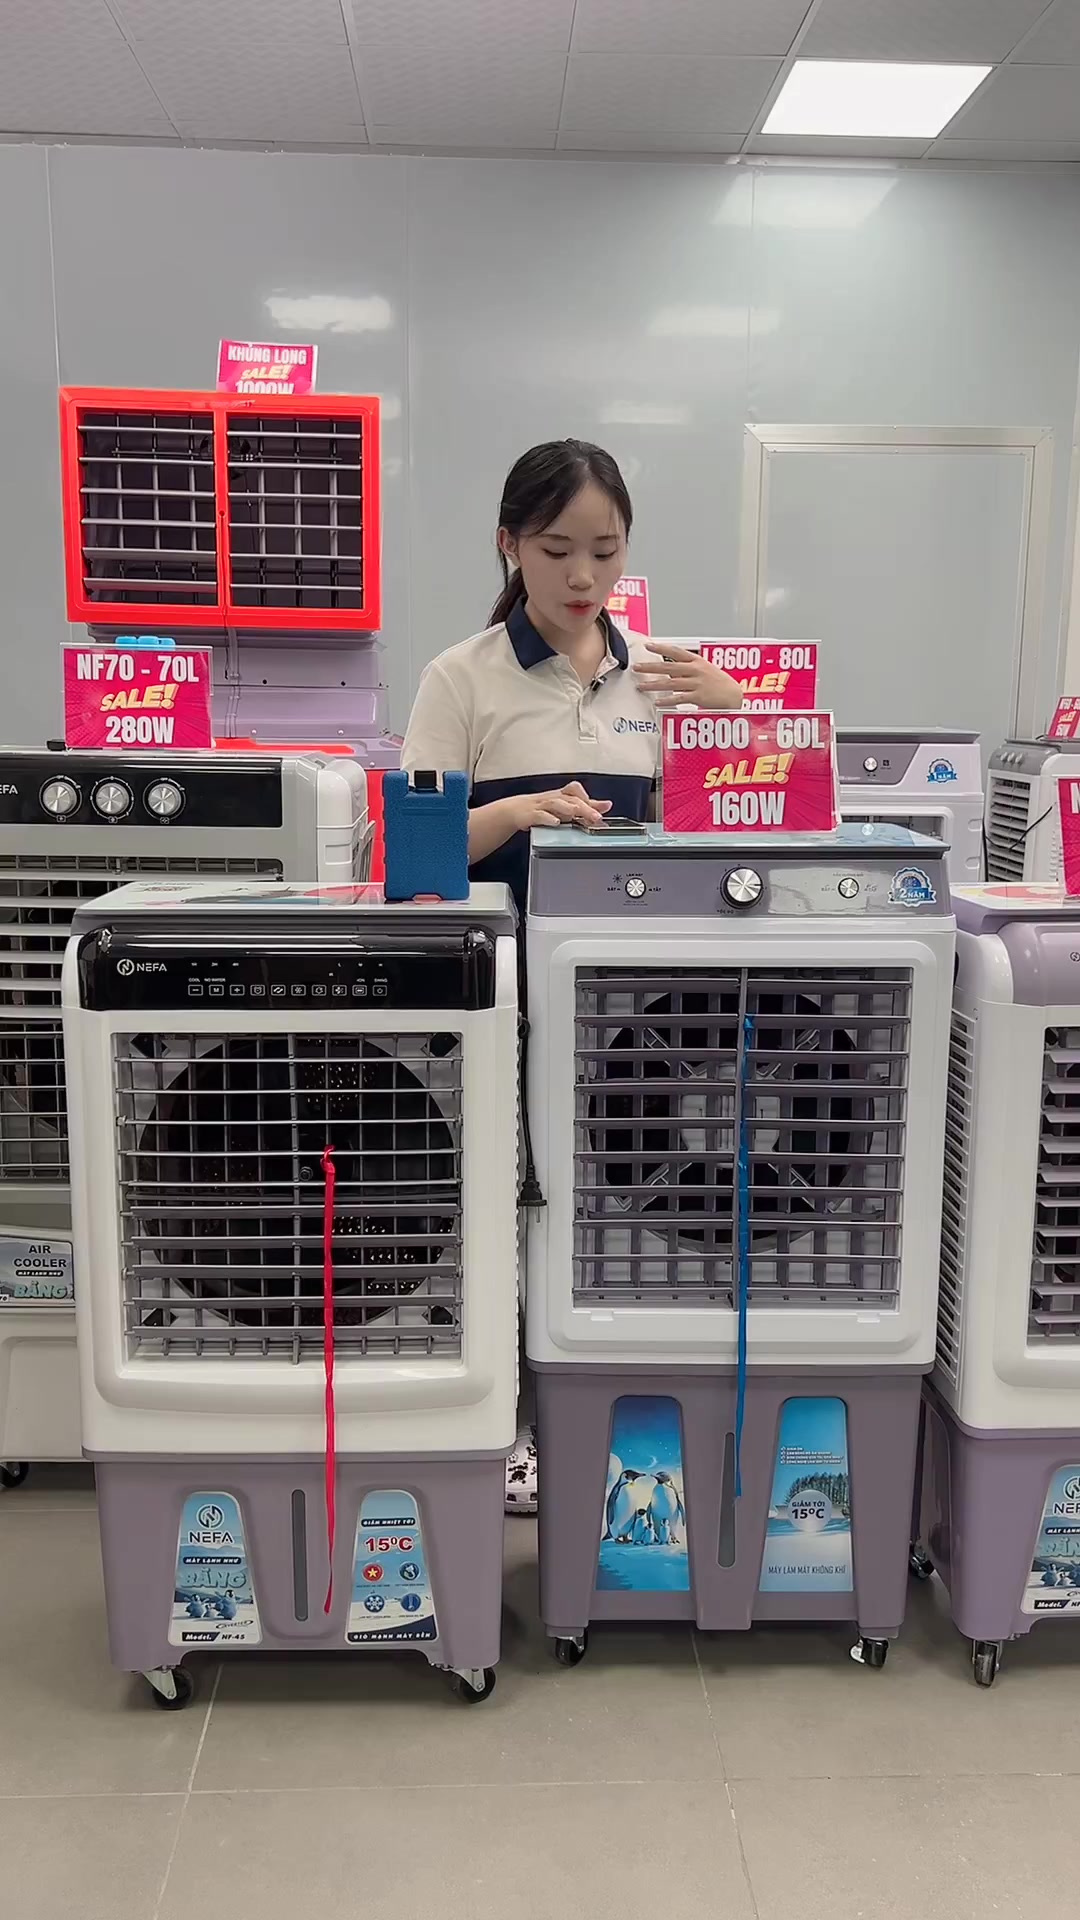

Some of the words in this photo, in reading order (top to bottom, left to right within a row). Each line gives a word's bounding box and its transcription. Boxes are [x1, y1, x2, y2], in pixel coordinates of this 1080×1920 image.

[228, 343, 270, 363] KHỦNG
[275, 349, 307, 365] LONG
[241, 364, 292, 380] SALE!
[76, 653, 134, 681] NF70
[157, 655, 200, 683] 70L
[779, 646, 814, 670] 80L
[739, 671, 791, 694] ALE!
[100, 683, 179, 712] SALE!
[105, 716, 174, 744] 280W
[667, 718, 749, 750] L6800
[776, 718, 825, 749] 60L
[703, 752, 795, 789] SALE!
[708, 791, 786, 826] 160W
[900, 887, 908, 899] 2
[136, 963, 168, 973] NEFA
[29, 1245, 51, 1254] AIR
[14, 1258, 67, 1268] COOLER
[14, 1281, 67, 1299] BĂNG
[791, 1508, 825, 1519] 15°C
[190, 1531, 233, 1543] NEFA
[769, 1565, 781, 1574] MÁY
[783, 1565, 796, 1574] LÀM
[797, 1565, 810, 1574] MÁT
[812, 1564, 833, 1574] KHÔNG
